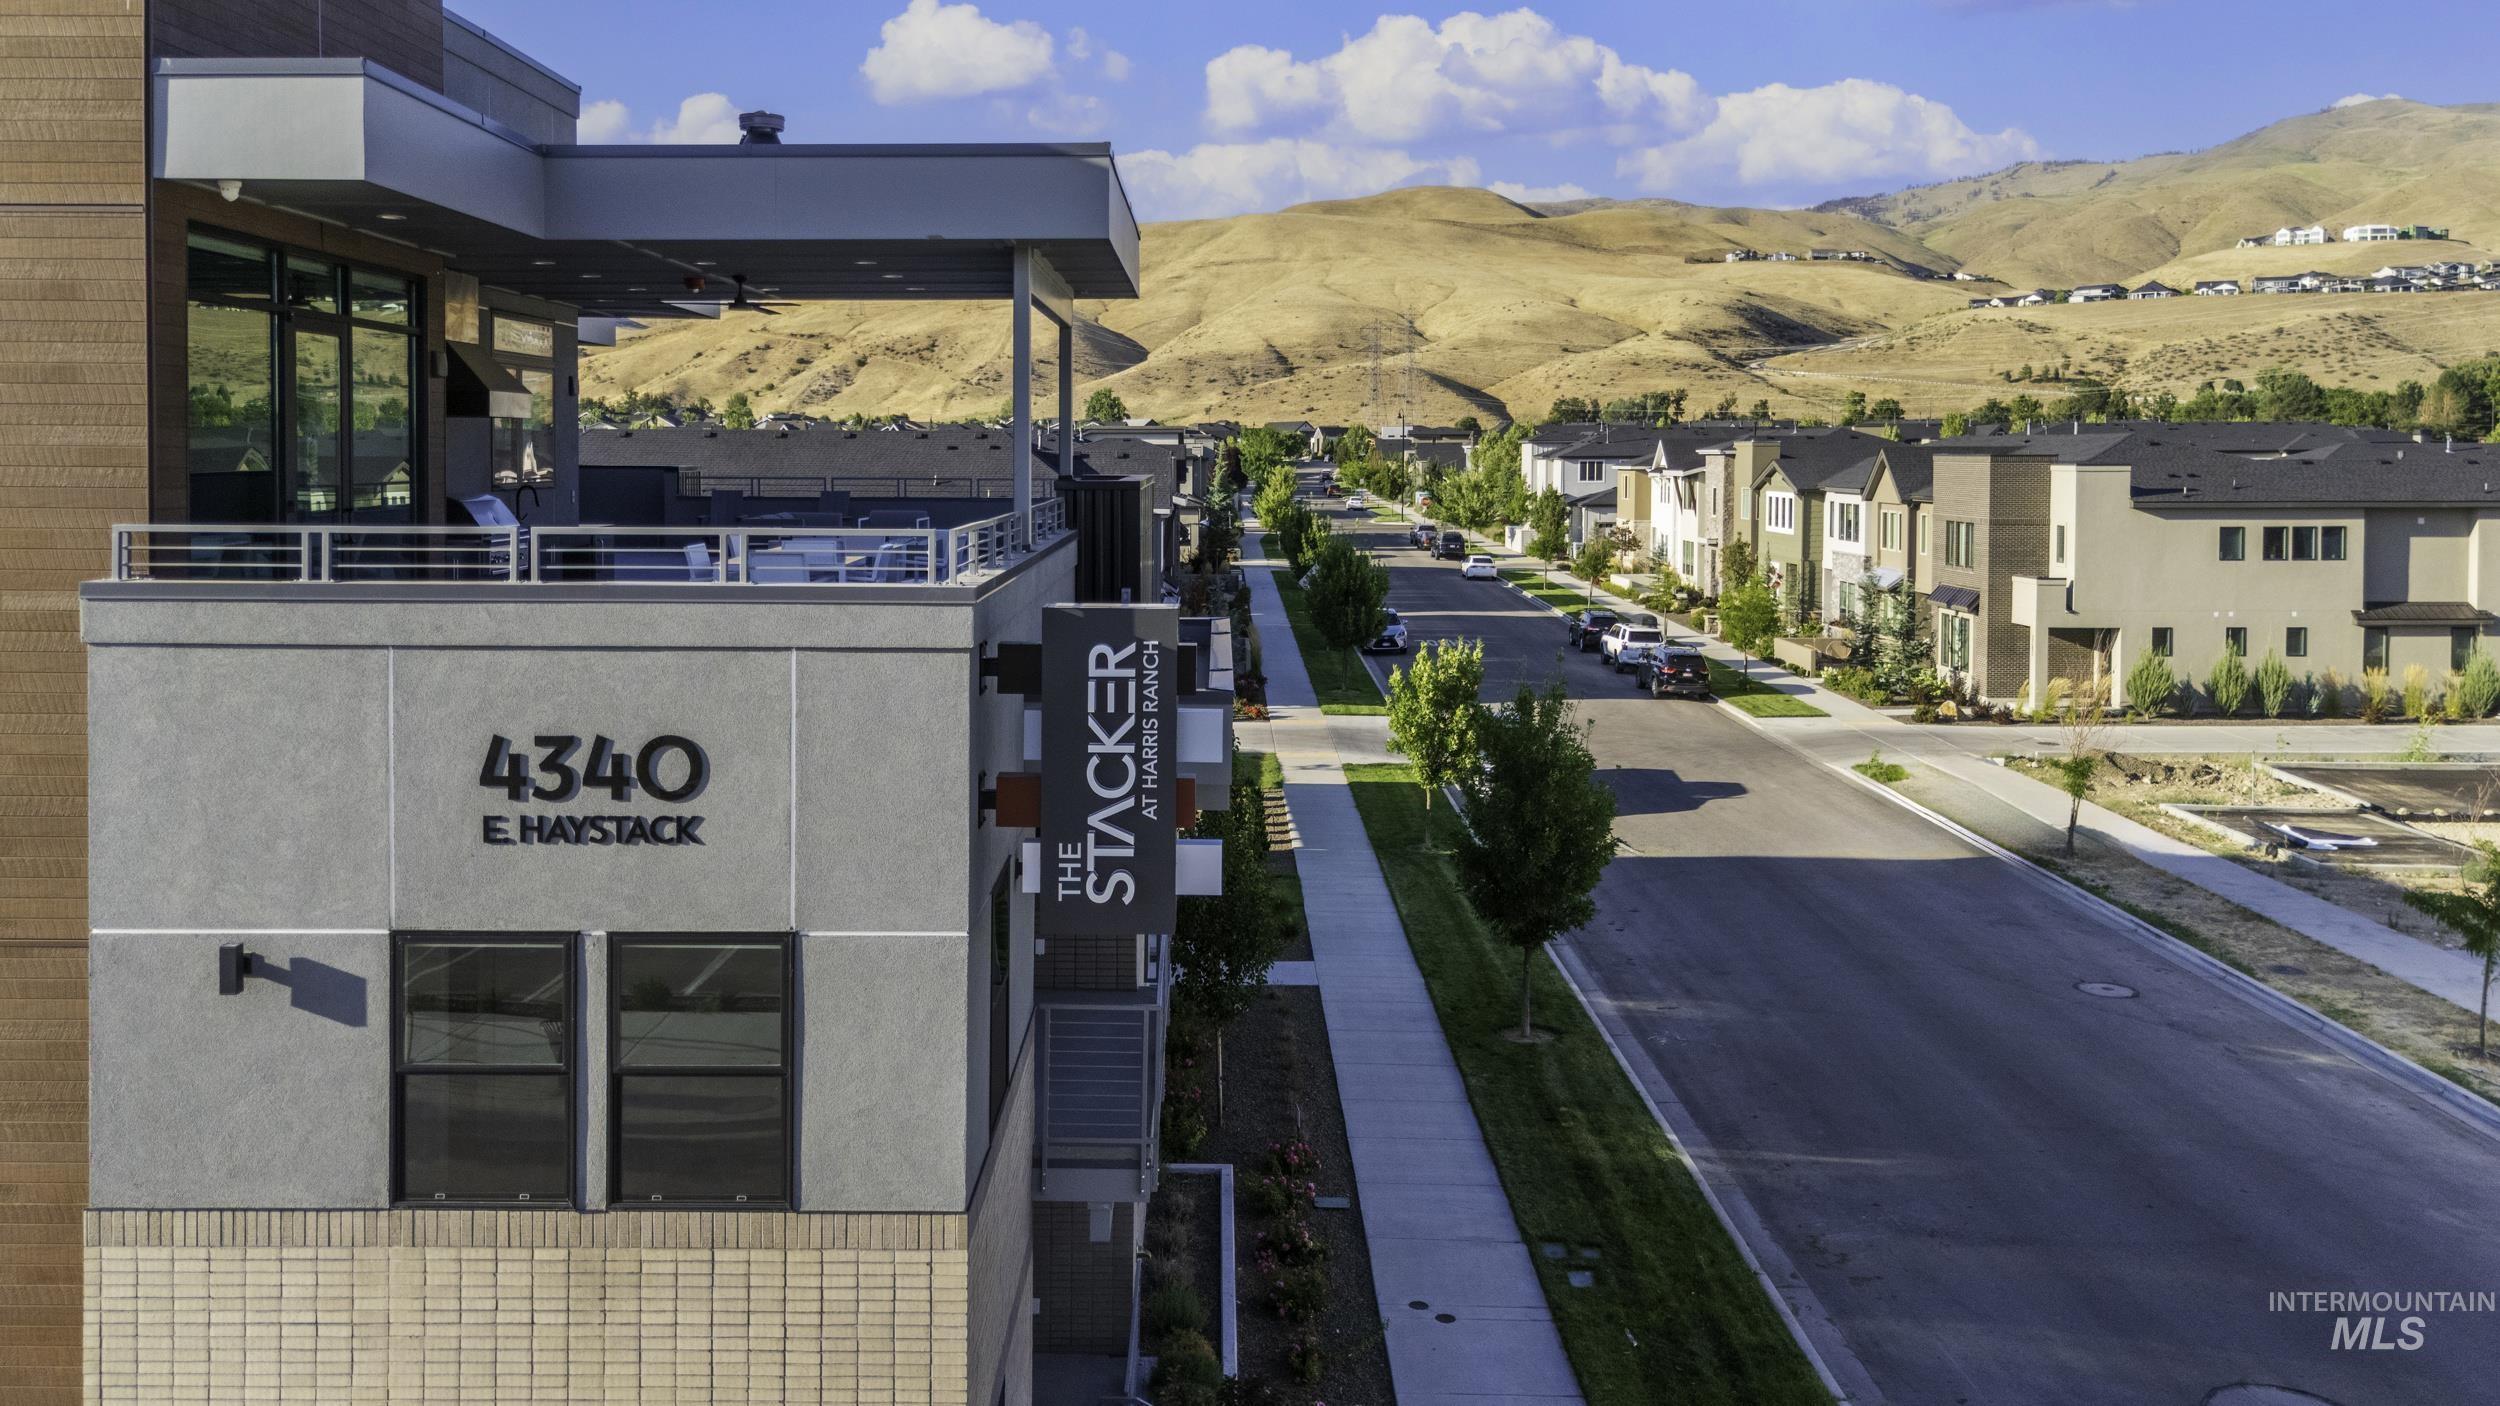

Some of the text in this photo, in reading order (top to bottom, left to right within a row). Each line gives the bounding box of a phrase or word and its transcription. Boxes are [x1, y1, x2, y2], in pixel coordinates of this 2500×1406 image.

[1142, 641, 1158, 820] AT HARRIS RANCH
[479, 734, 709, 802] 4340
[1086, 642, 1136, 905] STACKER
[519, 814, 705, 846] HAYSTACK
[1058, 842, 1082, 902] THE
